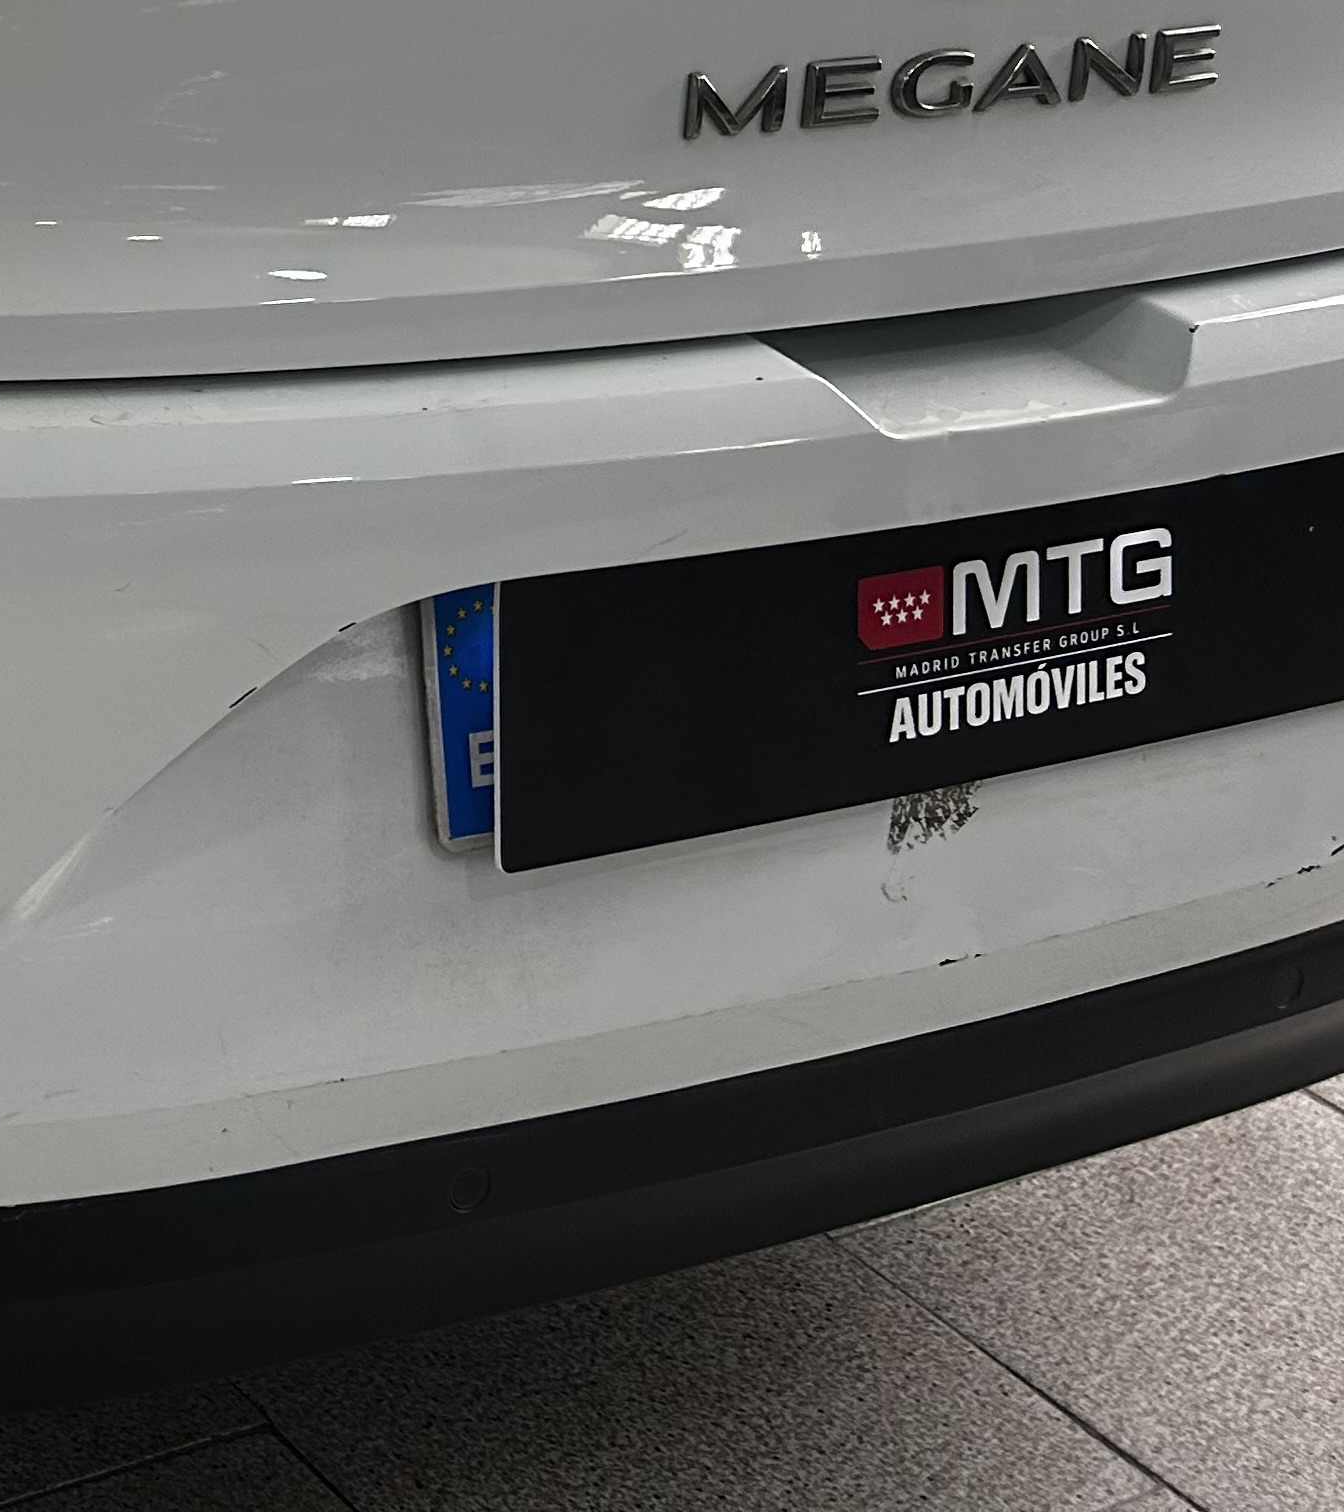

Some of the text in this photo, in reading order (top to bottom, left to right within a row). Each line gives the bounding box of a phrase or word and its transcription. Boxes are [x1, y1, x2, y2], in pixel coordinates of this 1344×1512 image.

[684, 23, 1222, 140] MEGANE
[952, 527, 1173, 636] MTG
[889, 651, 1147, 743] AUTOMÓVILES
[895, 655, 960, 680] MADRID
[968, 638, 1052, 665] TRANSFER
[1058, 627, 1110, 649] GROUP
